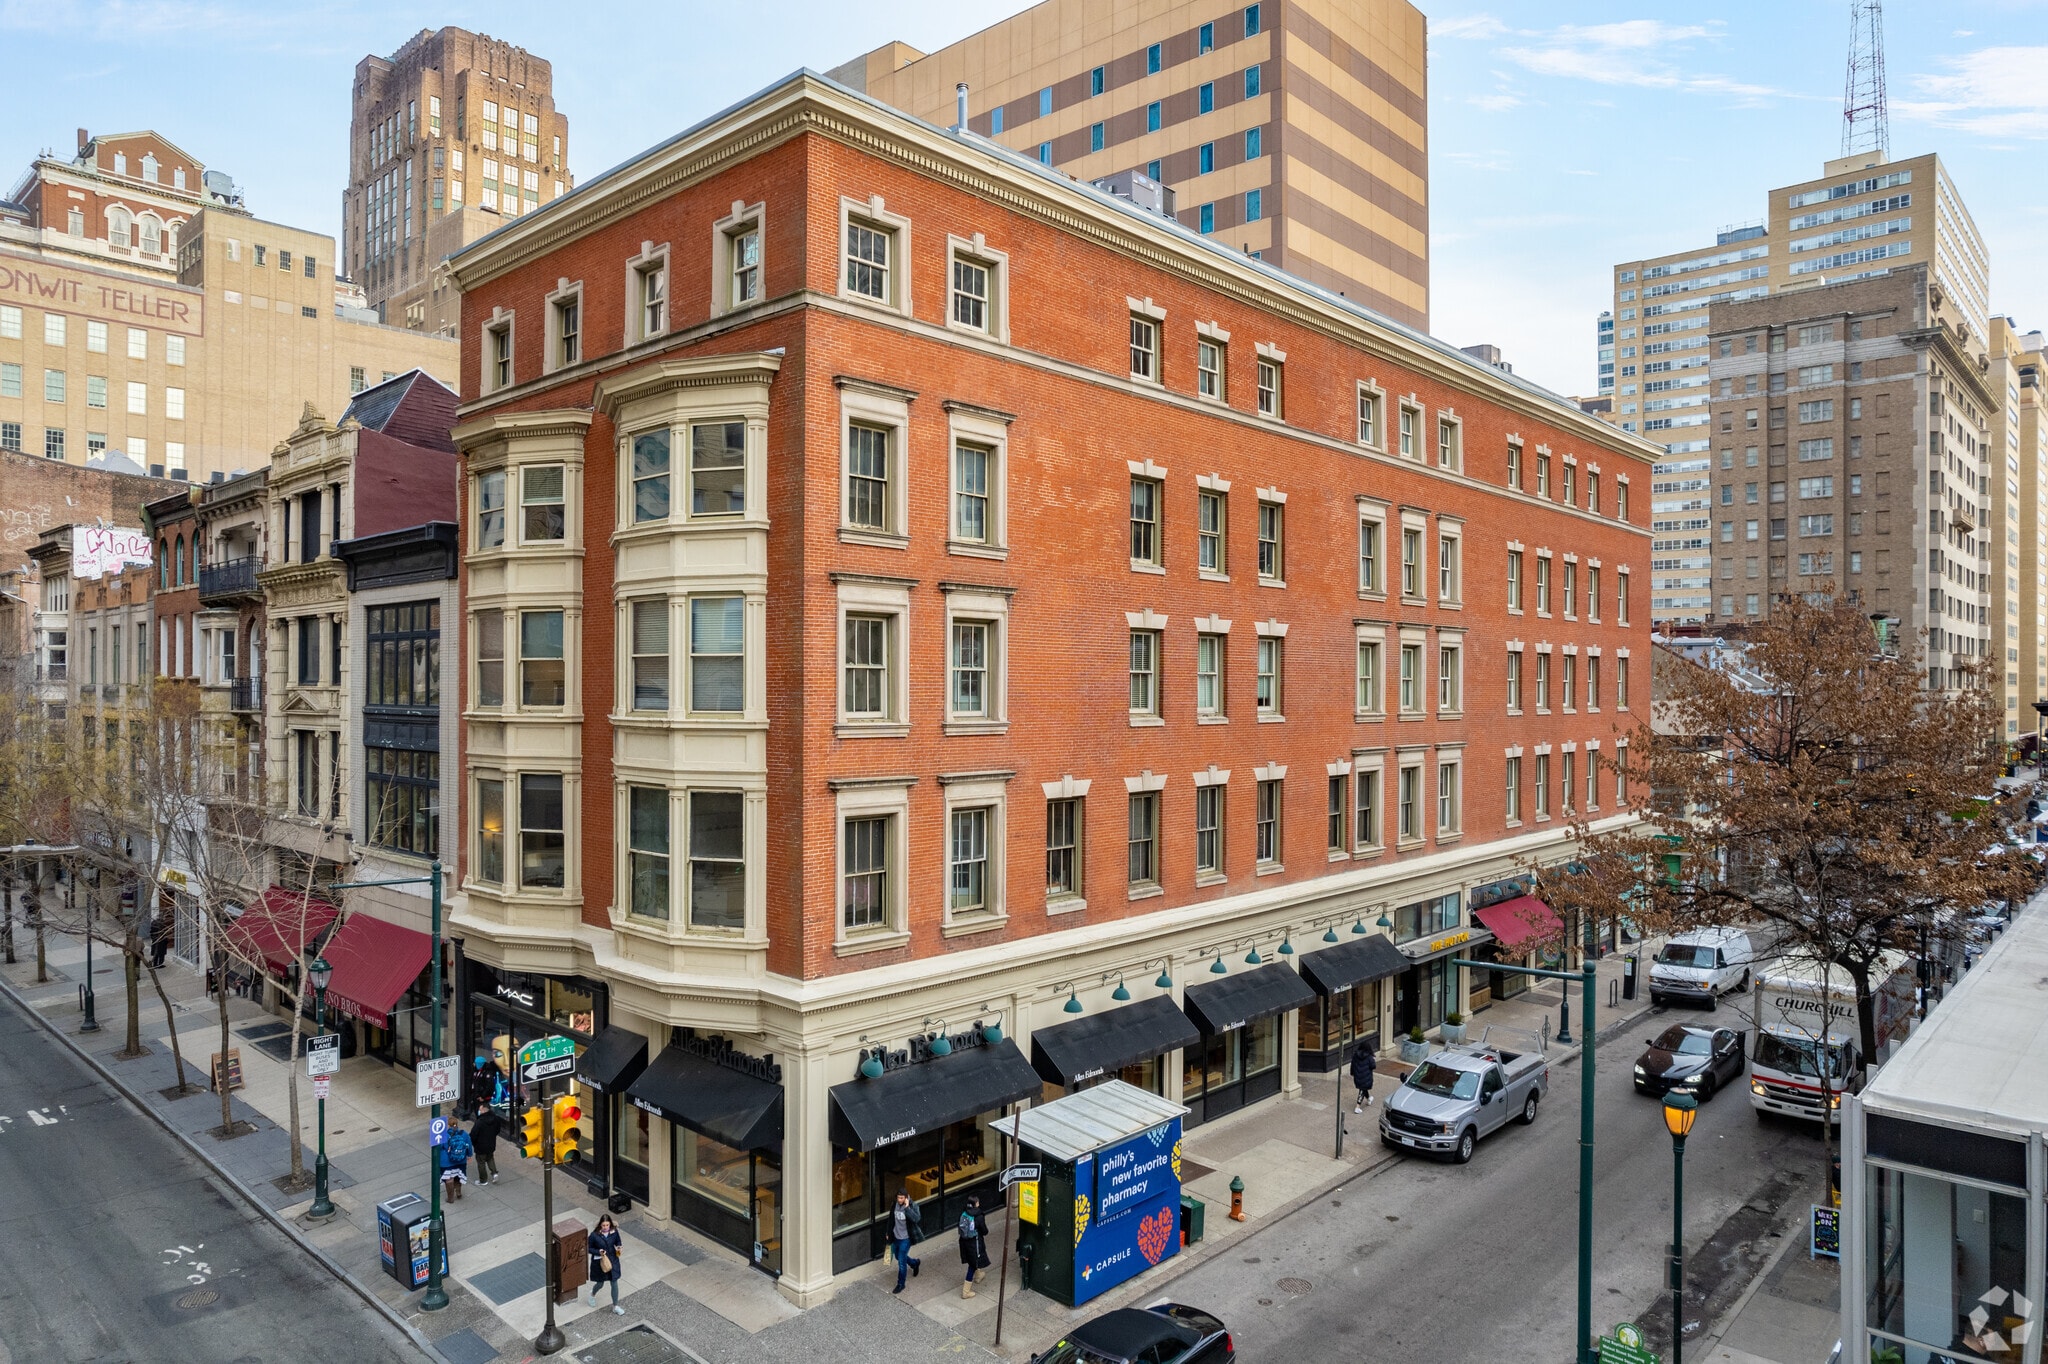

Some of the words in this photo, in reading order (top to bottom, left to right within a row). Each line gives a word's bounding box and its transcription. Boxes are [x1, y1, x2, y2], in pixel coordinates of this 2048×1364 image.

[97, 286, 189, 323] TELLER
[497, 984, 533, 1006] MAC
[313, 1036, 333, 1045] RIGHT
[563, 1046, 573, 1055] ST
[438, 1059, 458, 1069] BLOCK
[537, 1065, 552, 1074] ONE
[554, 1060, 569, 1070] WAY
[420, 1094, 436, 1105] THE
[440, 1089, 457, 1101] BOX
[875, 1135, 890, 1148] Allen
[890, 1126, 916, 1144] Edmonds
[1102, 1150, 1135, 1176] philly's
[1112, 1170, 1132, 1186] new
[1133, 1154, 1168, 1177] favorite
[1102, 1179, 1148, 1211] pharmacy
[1096, 1208, 1132, 1228] CAPSULE.COM
[1096, 1247, 1131, 1272] CAPSULE
